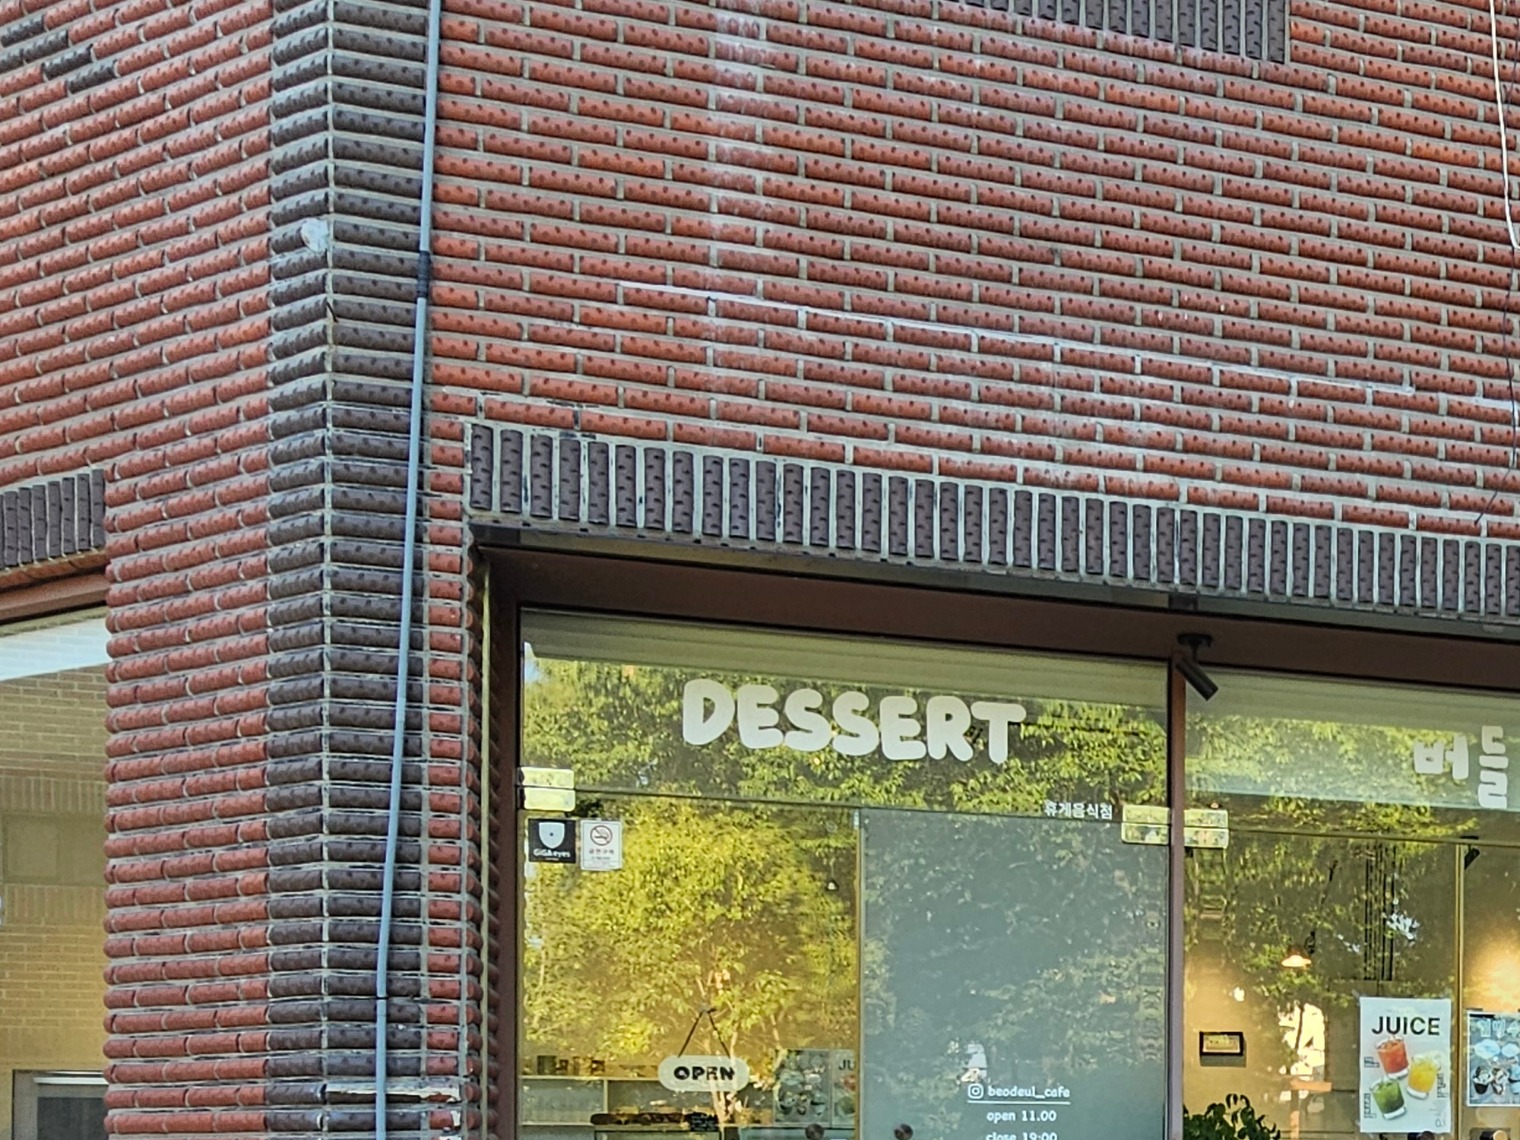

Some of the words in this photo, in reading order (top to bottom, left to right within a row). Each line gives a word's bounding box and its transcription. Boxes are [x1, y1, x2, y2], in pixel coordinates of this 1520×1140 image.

[682, 679, 1027, 764] DESSERT
[1413, 725, 1509, 810] 버들
[1044, 799, 1113, 820] 휴게음식점
[1371, 1015, 1441, 1036] JUICE
[673, 1066, 736, 1081] OPEN
[987, 1085, 1071, 1099] beodeul_cafe
[986, 1112, 1016, 1124] open
[1021, 1110, 1057, 1121] 11.00
